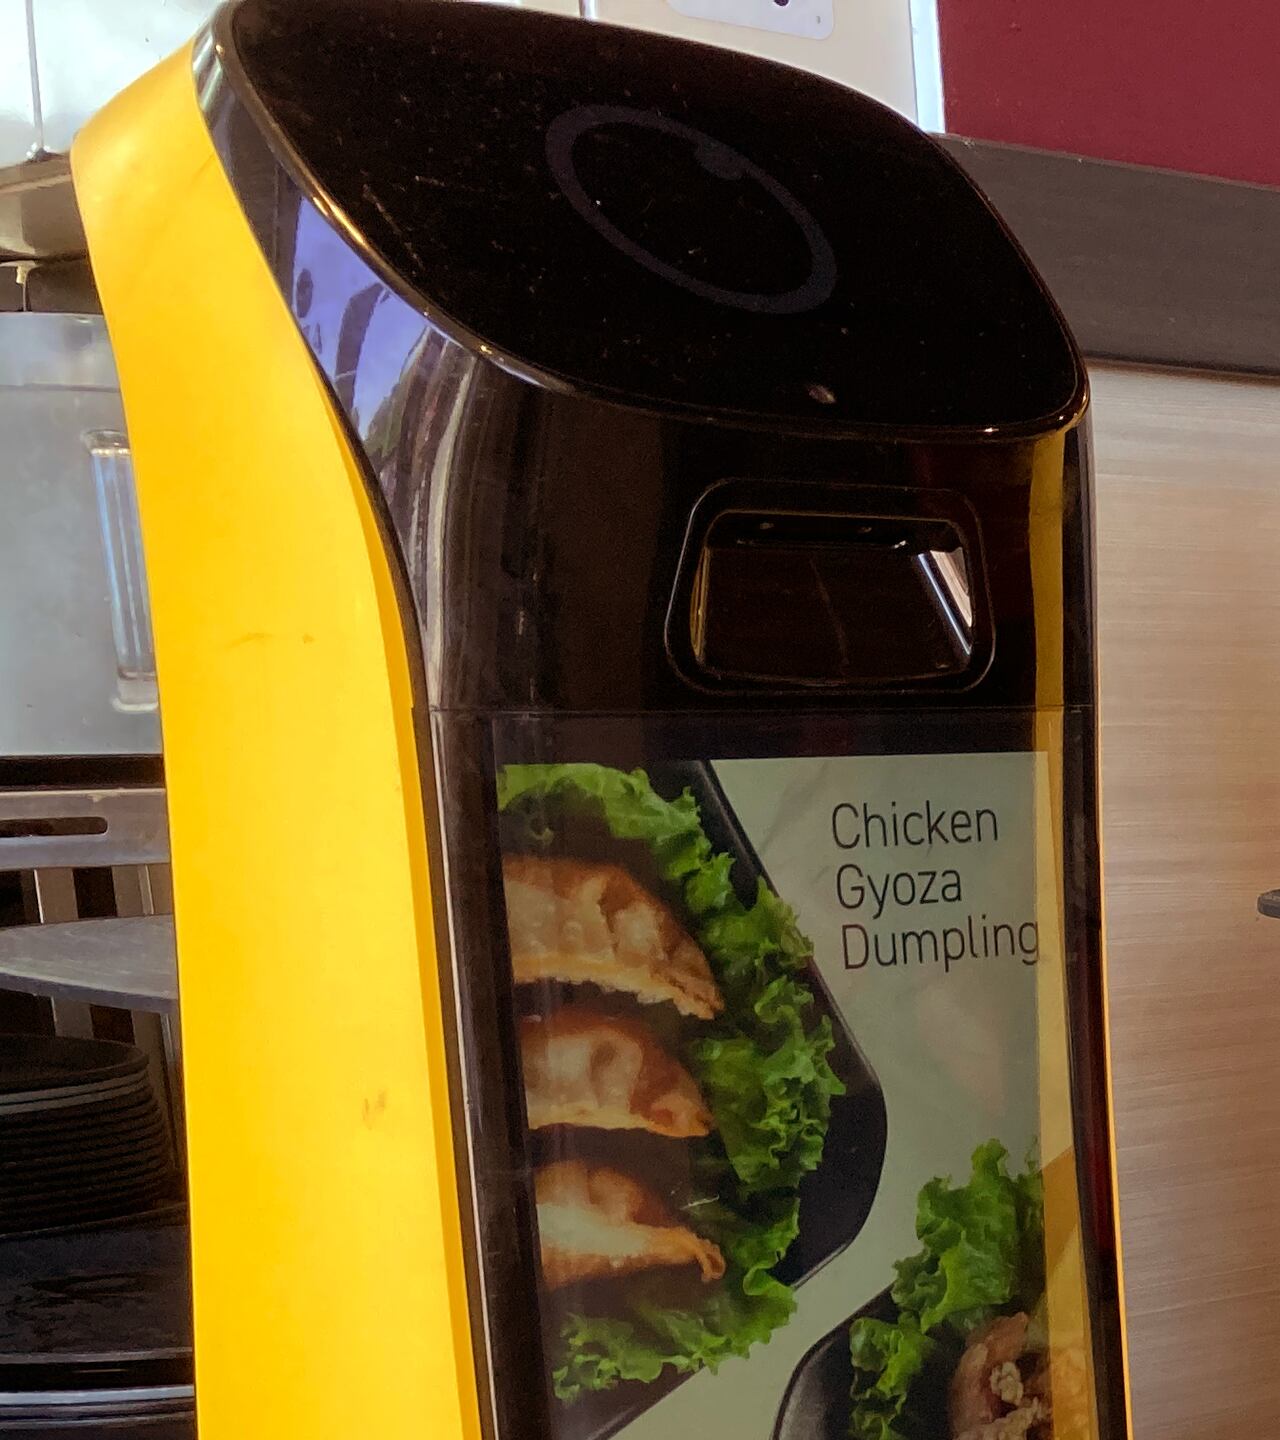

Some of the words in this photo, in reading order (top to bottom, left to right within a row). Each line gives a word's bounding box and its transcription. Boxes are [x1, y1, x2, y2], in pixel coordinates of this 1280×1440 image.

[832, 799, 998, 849] Chicken
[836, 863, 962, 920] Gyoza
[841, 913, 1041, 973] Dumpling
